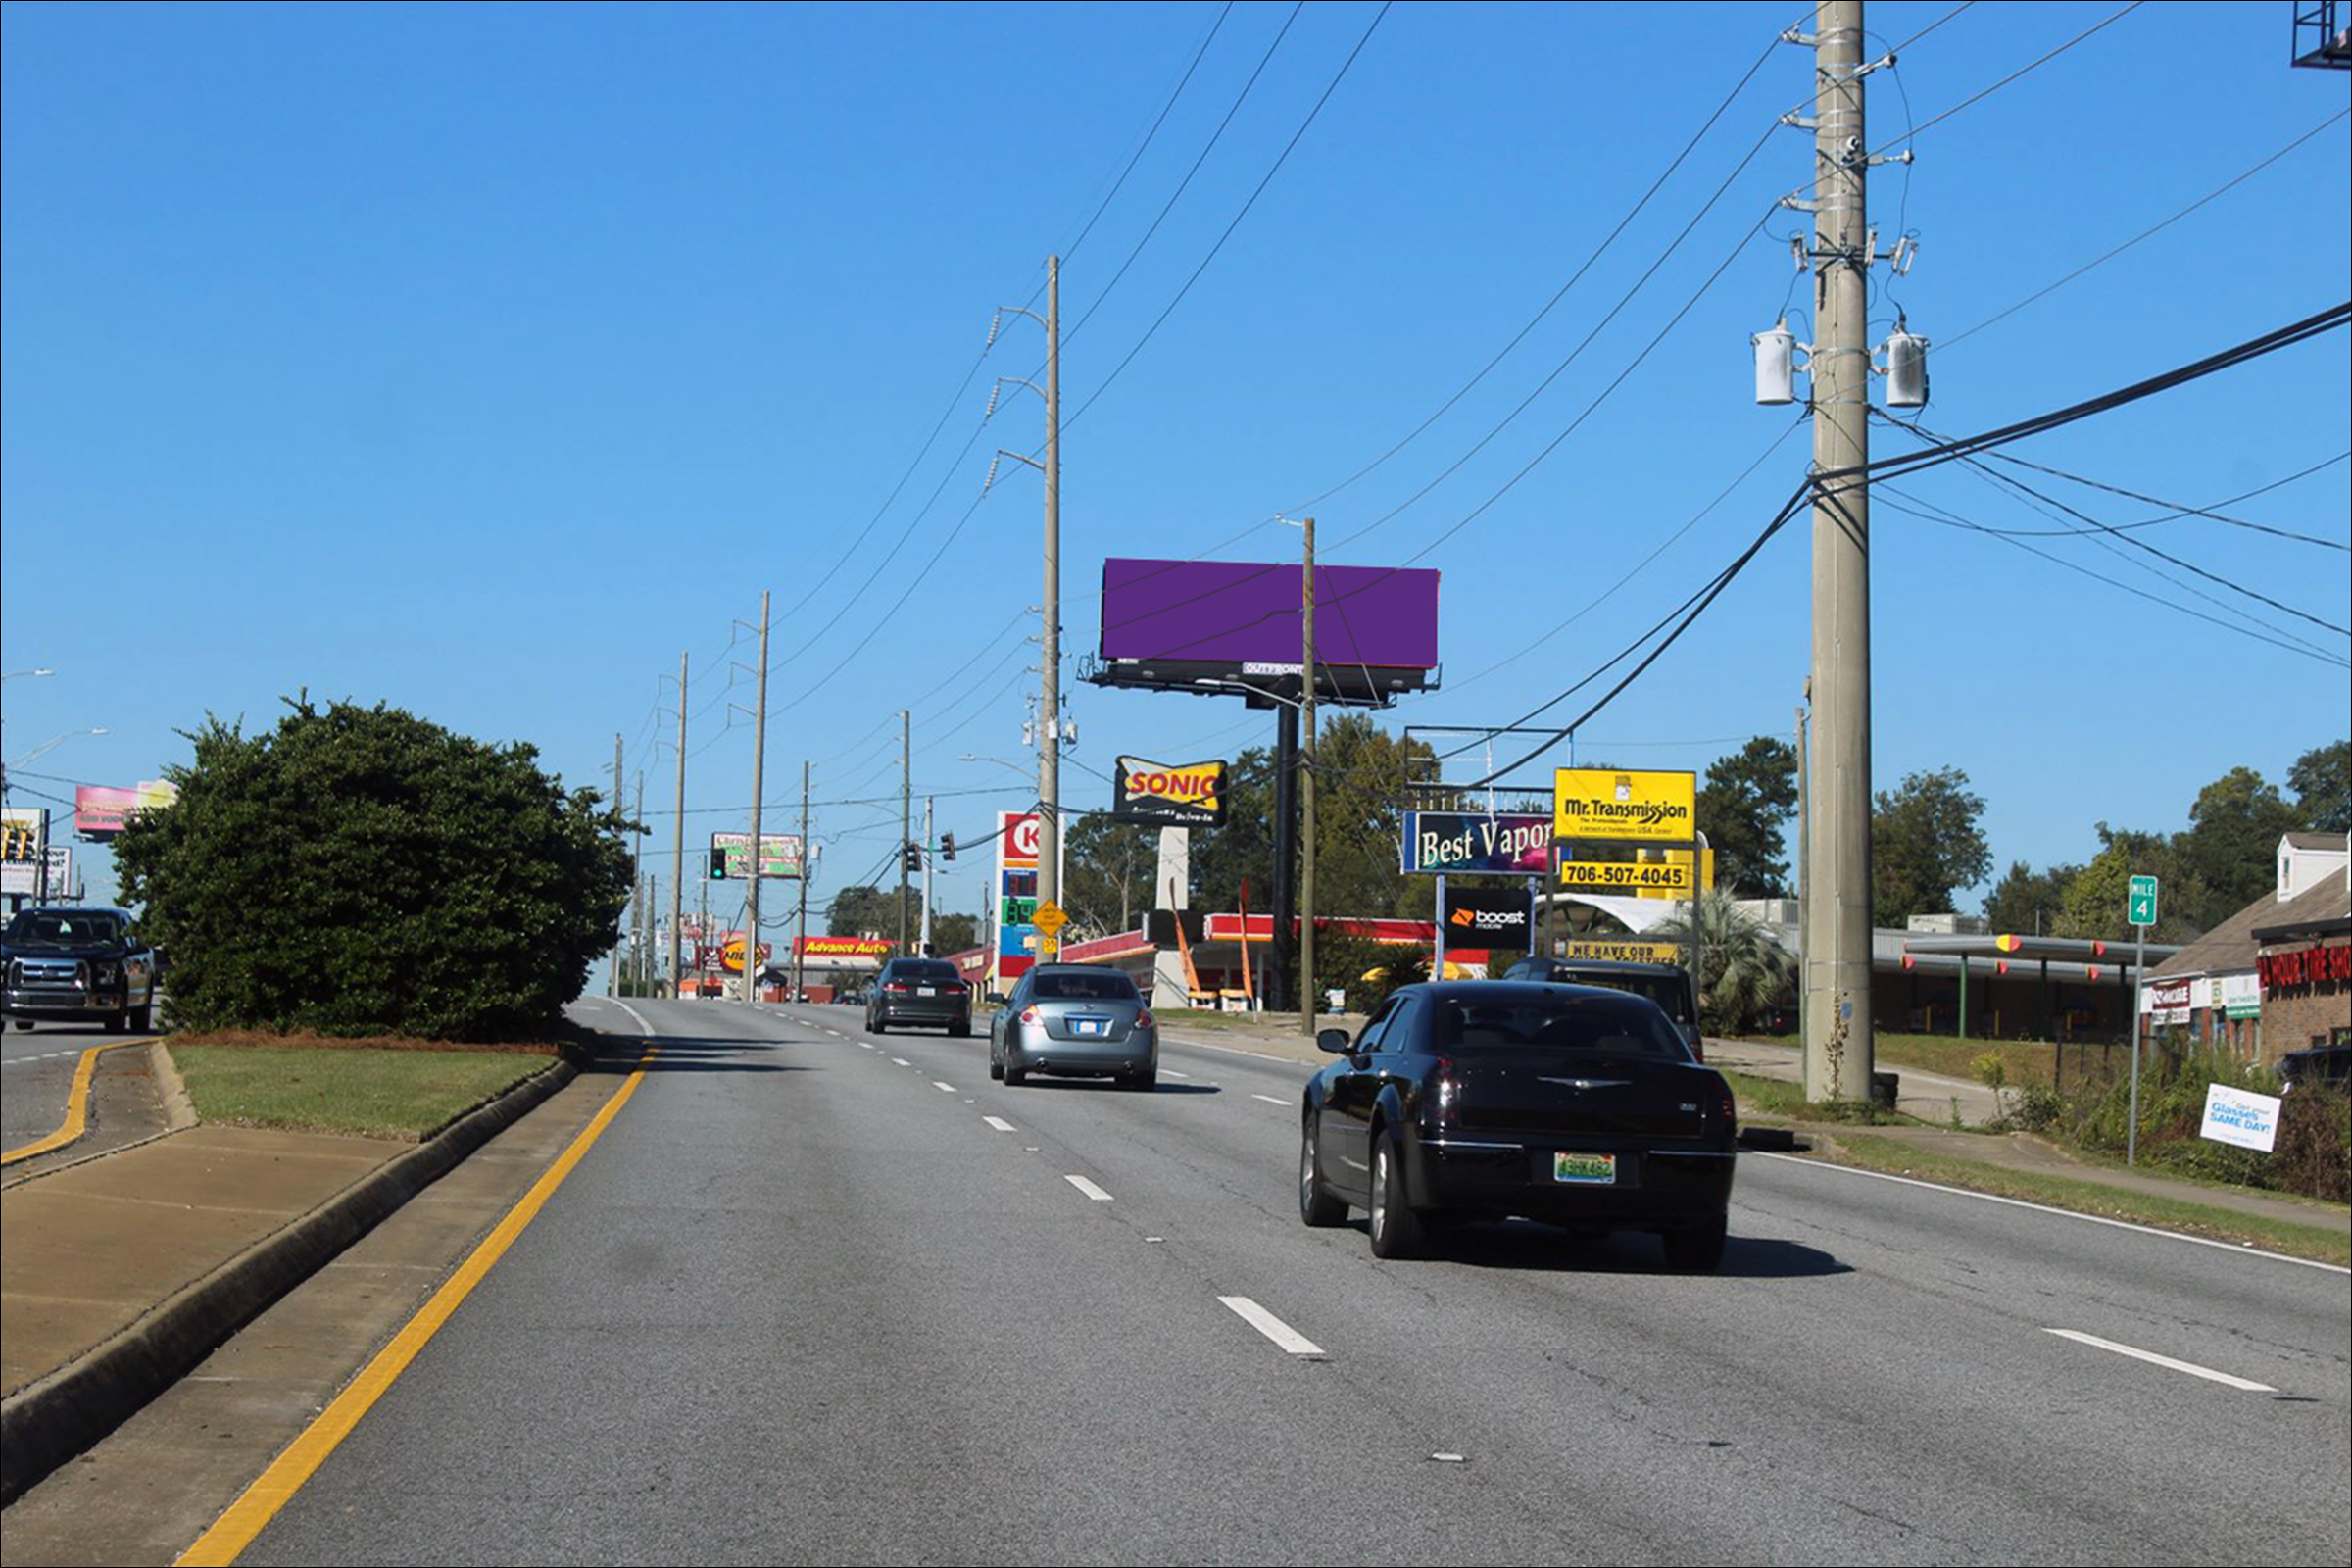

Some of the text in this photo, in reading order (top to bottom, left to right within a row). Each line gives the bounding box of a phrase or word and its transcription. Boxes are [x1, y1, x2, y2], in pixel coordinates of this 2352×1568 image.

[1130, 772, 1216, 796] SONIC
[1565, 799, 1687, 824] Mr. Transmission
[1422, 828, 1473, 866] Best
[1568, 866, 1682, 883] 706-507-4045
[2132, 884, 2153, 897] MILE
[1476, 910, 1525, 924] boost
[2136, 900, 2147, 917] 4
[806, 941, 888, 954] Advance Auto
[1574, 945, 1654, 957] WE HAVE OUR
[2209, 1111, 2241, 1128] SAME
[2211, 1102, 2259, 1121] Glasses
